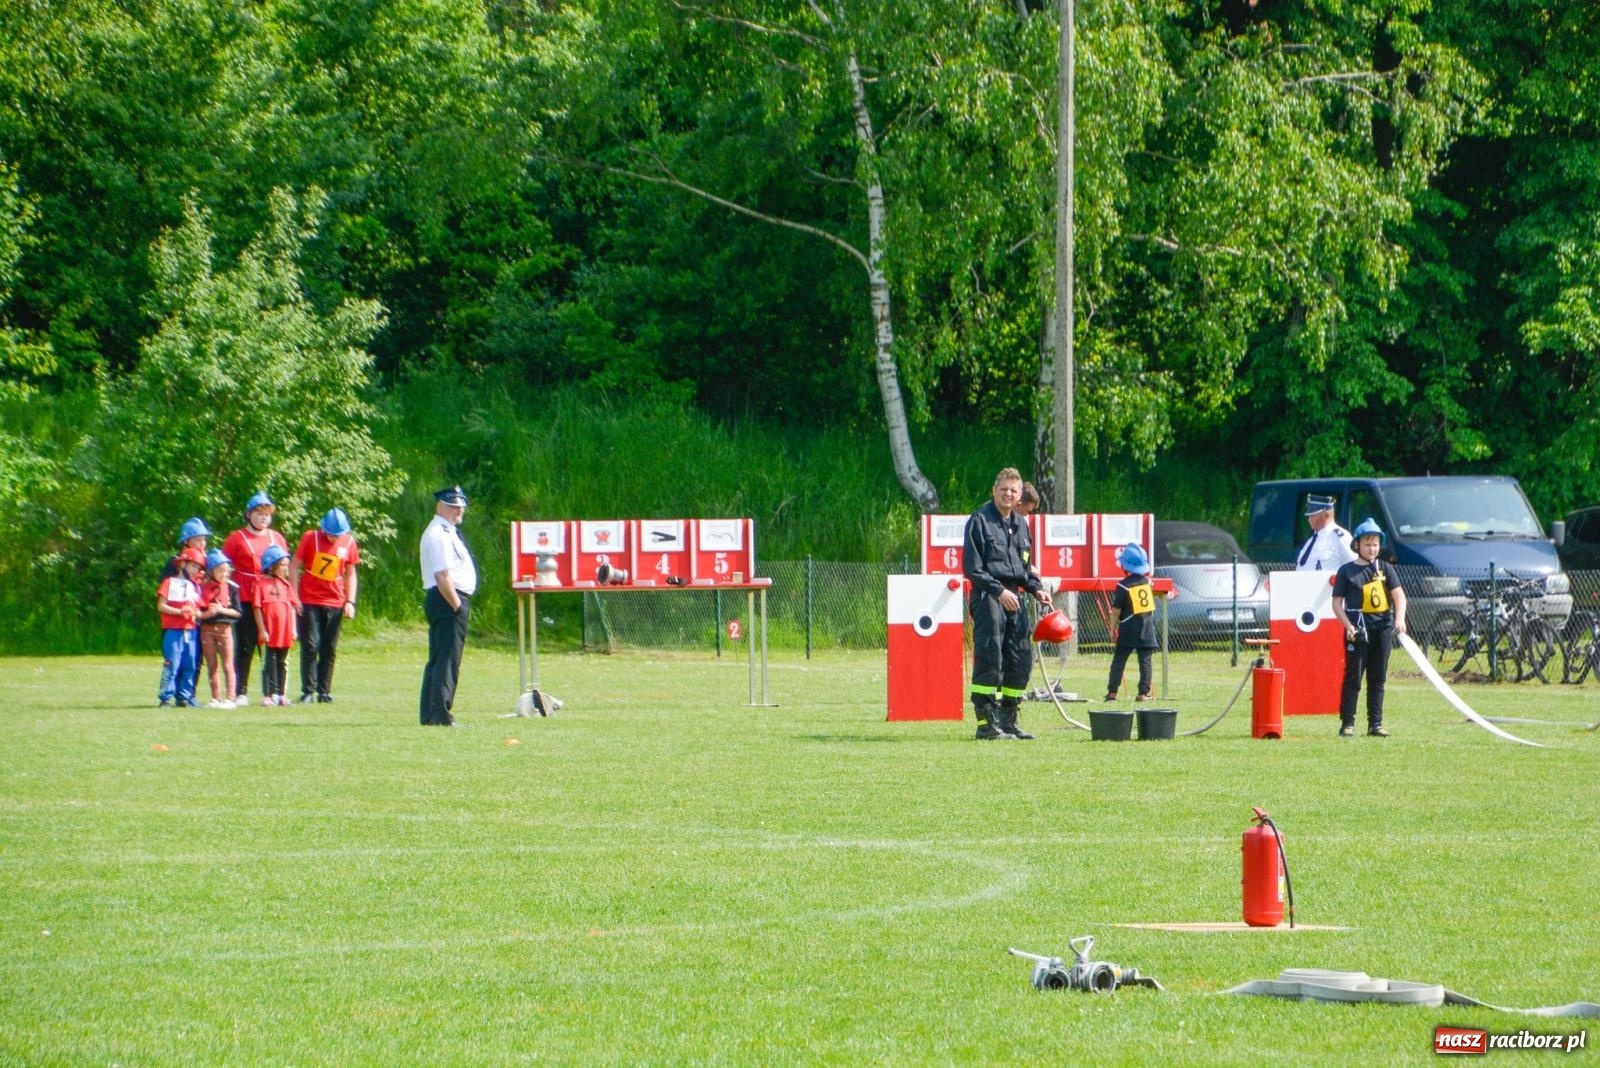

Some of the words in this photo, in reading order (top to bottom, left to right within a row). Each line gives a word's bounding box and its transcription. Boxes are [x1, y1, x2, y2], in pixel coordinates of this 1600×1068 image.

[319, 557, 333, 575] 7
[655, 553, 671, 575] 4
[714, 552, 729, 574] 5
[943, 547, 958, 569] 6
[1058, 547, 1073, 569] 8
[269, 583, 281, 599] 4
[1138, 589, 1149, 607] 8
[1370, 587, 1381, 608] 6
[730, 622, 740, 639] 2
